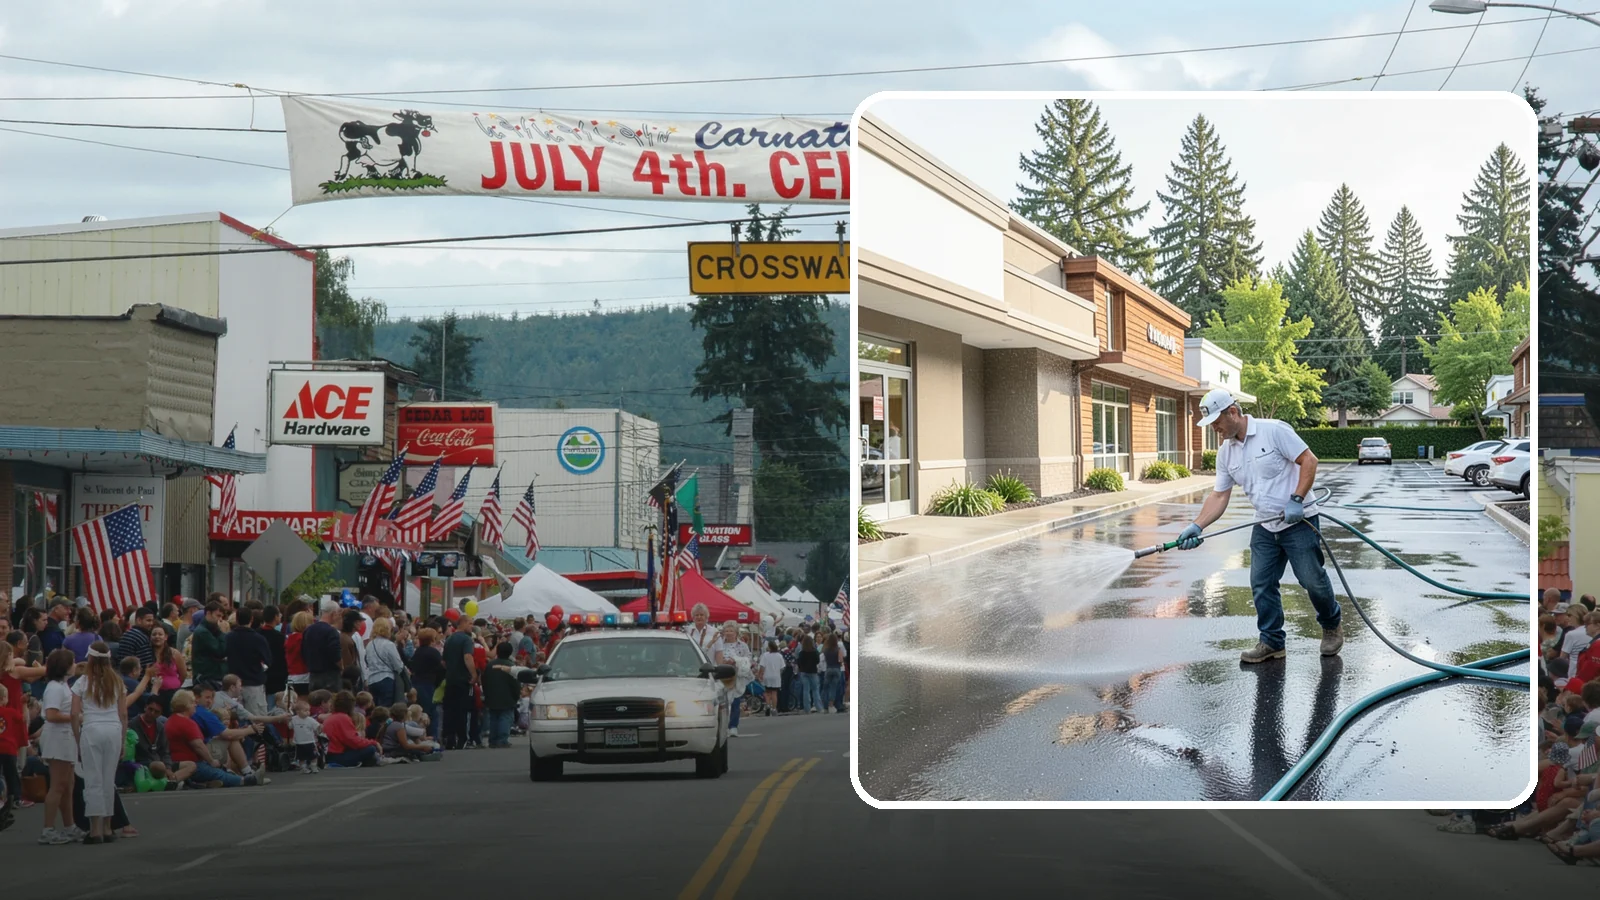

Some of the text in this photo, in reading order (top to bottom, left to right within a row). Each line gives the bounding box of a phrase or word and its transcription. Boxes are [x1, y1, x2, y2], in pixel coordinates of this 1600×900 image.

[481, 141, 605, 192] JULY
[632, 150, 746, 197] 4th.
[697, 254, 850, 280] CROSSWA
[283, 380, 373, 420] ACE
[406, 408, 485, 422] CEDAR LOG
[283, 421, 370, 436] Hardware
[83, 484, 155, 495] St. Vincent de Paul
[81, 503, 153, 521] THT
[212, 516, 330, 535] HARDARE
[688, 526, 741, 534] CRNATION
[699, 535, 730, 543] GLASS
